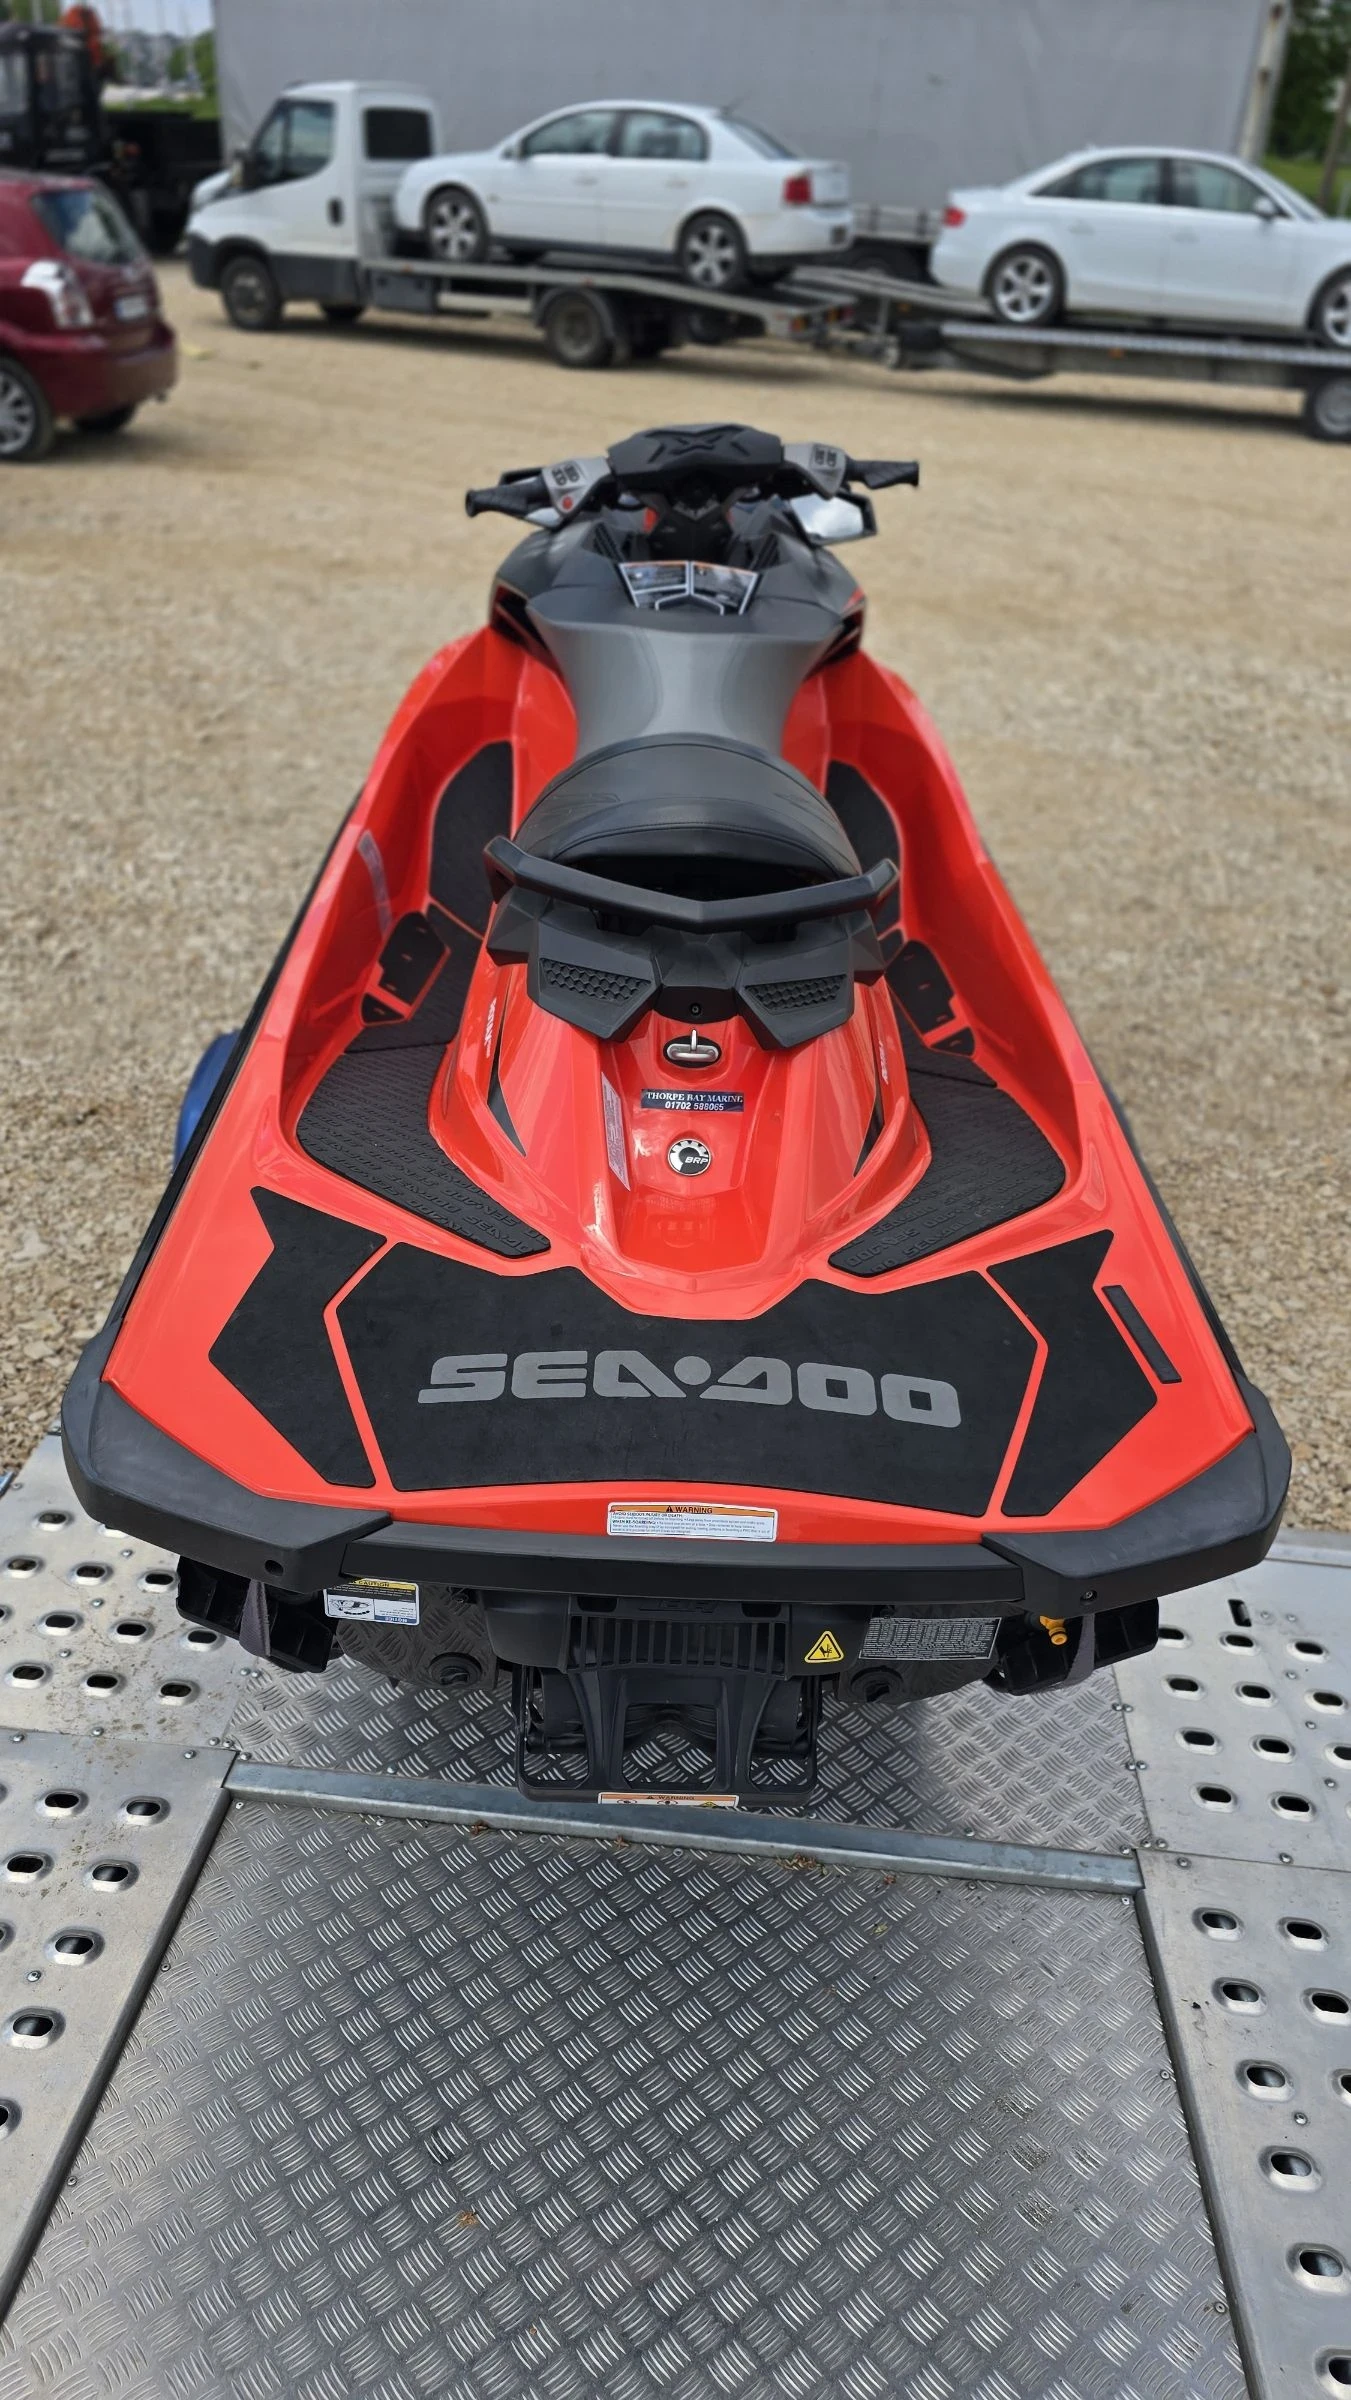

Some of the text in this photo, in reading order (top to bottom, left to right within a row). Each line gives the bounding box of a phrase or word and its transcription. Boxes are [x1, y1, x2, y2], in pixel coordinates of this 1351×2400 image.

[646, 1091, 743, 1103] THORPE BAY MARINE
[665, 1101, 692, 1110] 01702
[684, 1156, 709, 1164] BRP
[675, 1506, 713, 1514] WARNING
[358, 1580, 391, 1588] CAUTION
